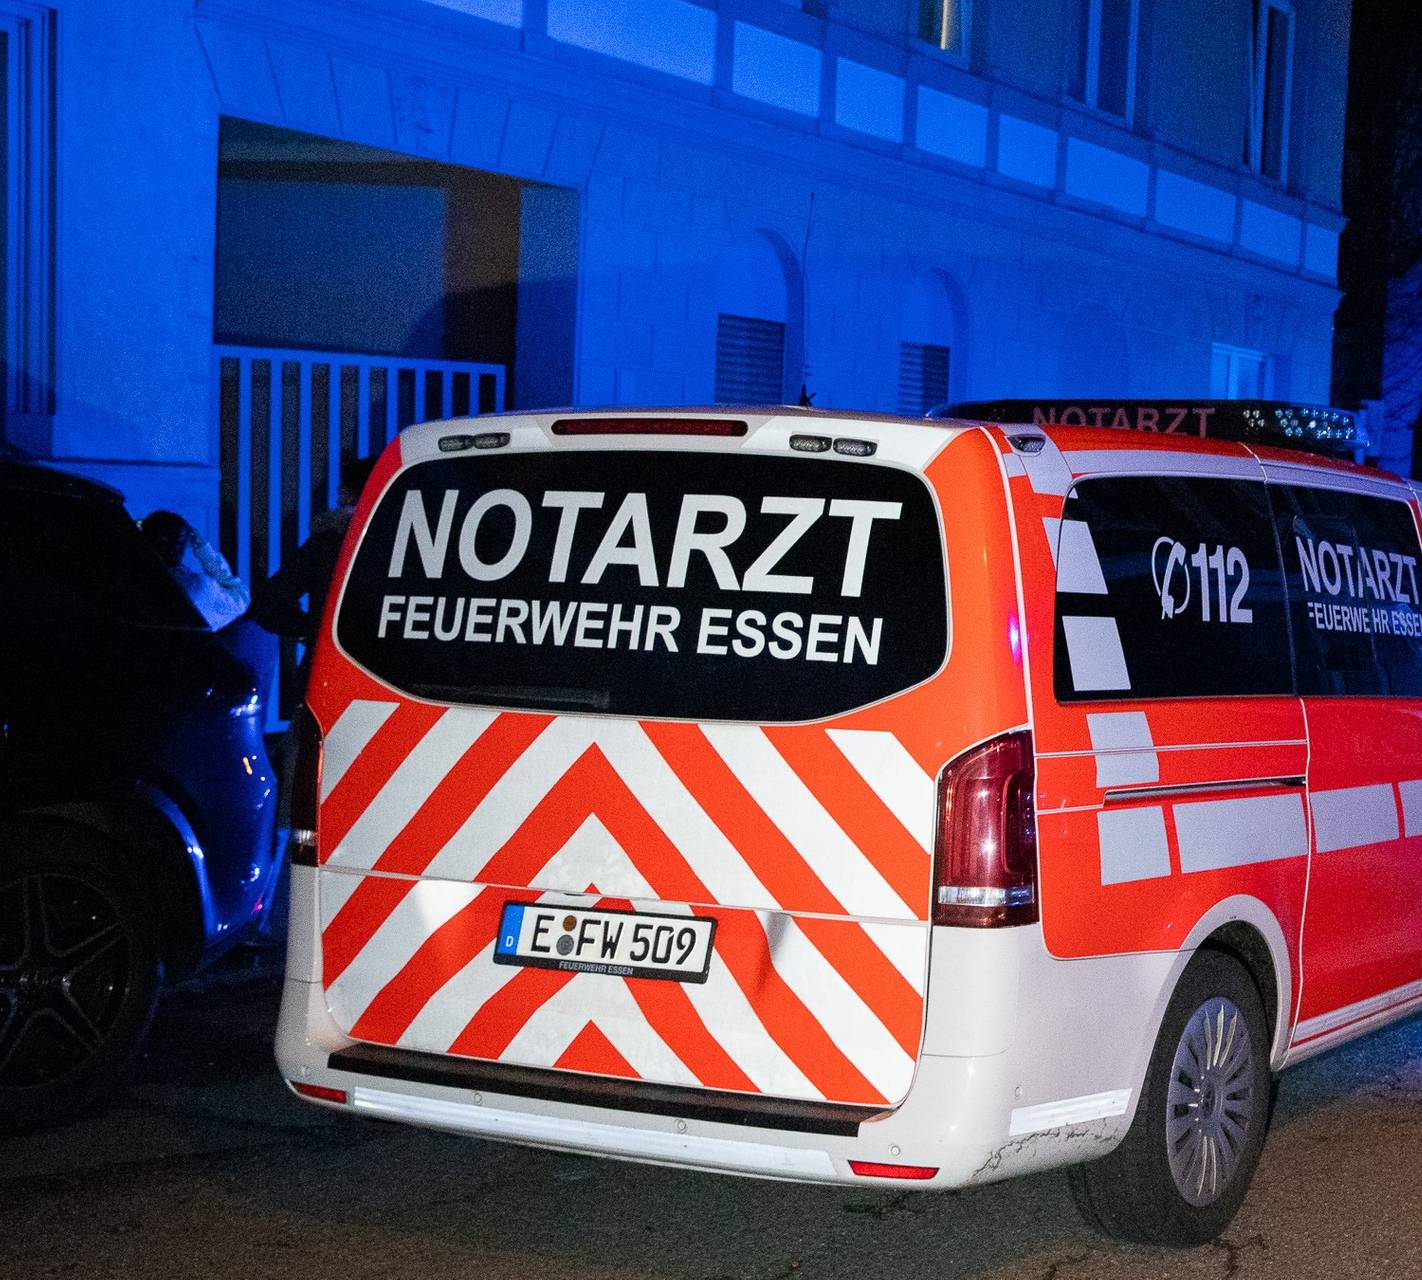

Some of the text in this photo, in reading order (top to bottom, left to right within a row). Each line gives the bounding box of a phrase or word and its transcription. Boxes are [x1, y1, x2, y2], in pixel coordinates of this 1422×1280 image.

[1032, 406, 1216, 438] NOTARZT
[387, 489, 903, 598] NOTARZT
[1296, 536, 1419, 605] NOTARZT
[1191, 542, 1253, 624] 112
[377, 595, 883, 666] FEUERWEHR ESSEN
[505, 914, 697, 966] D E FW 509
[558, 960, 634, 976] FEUERWEHR ESSEN
